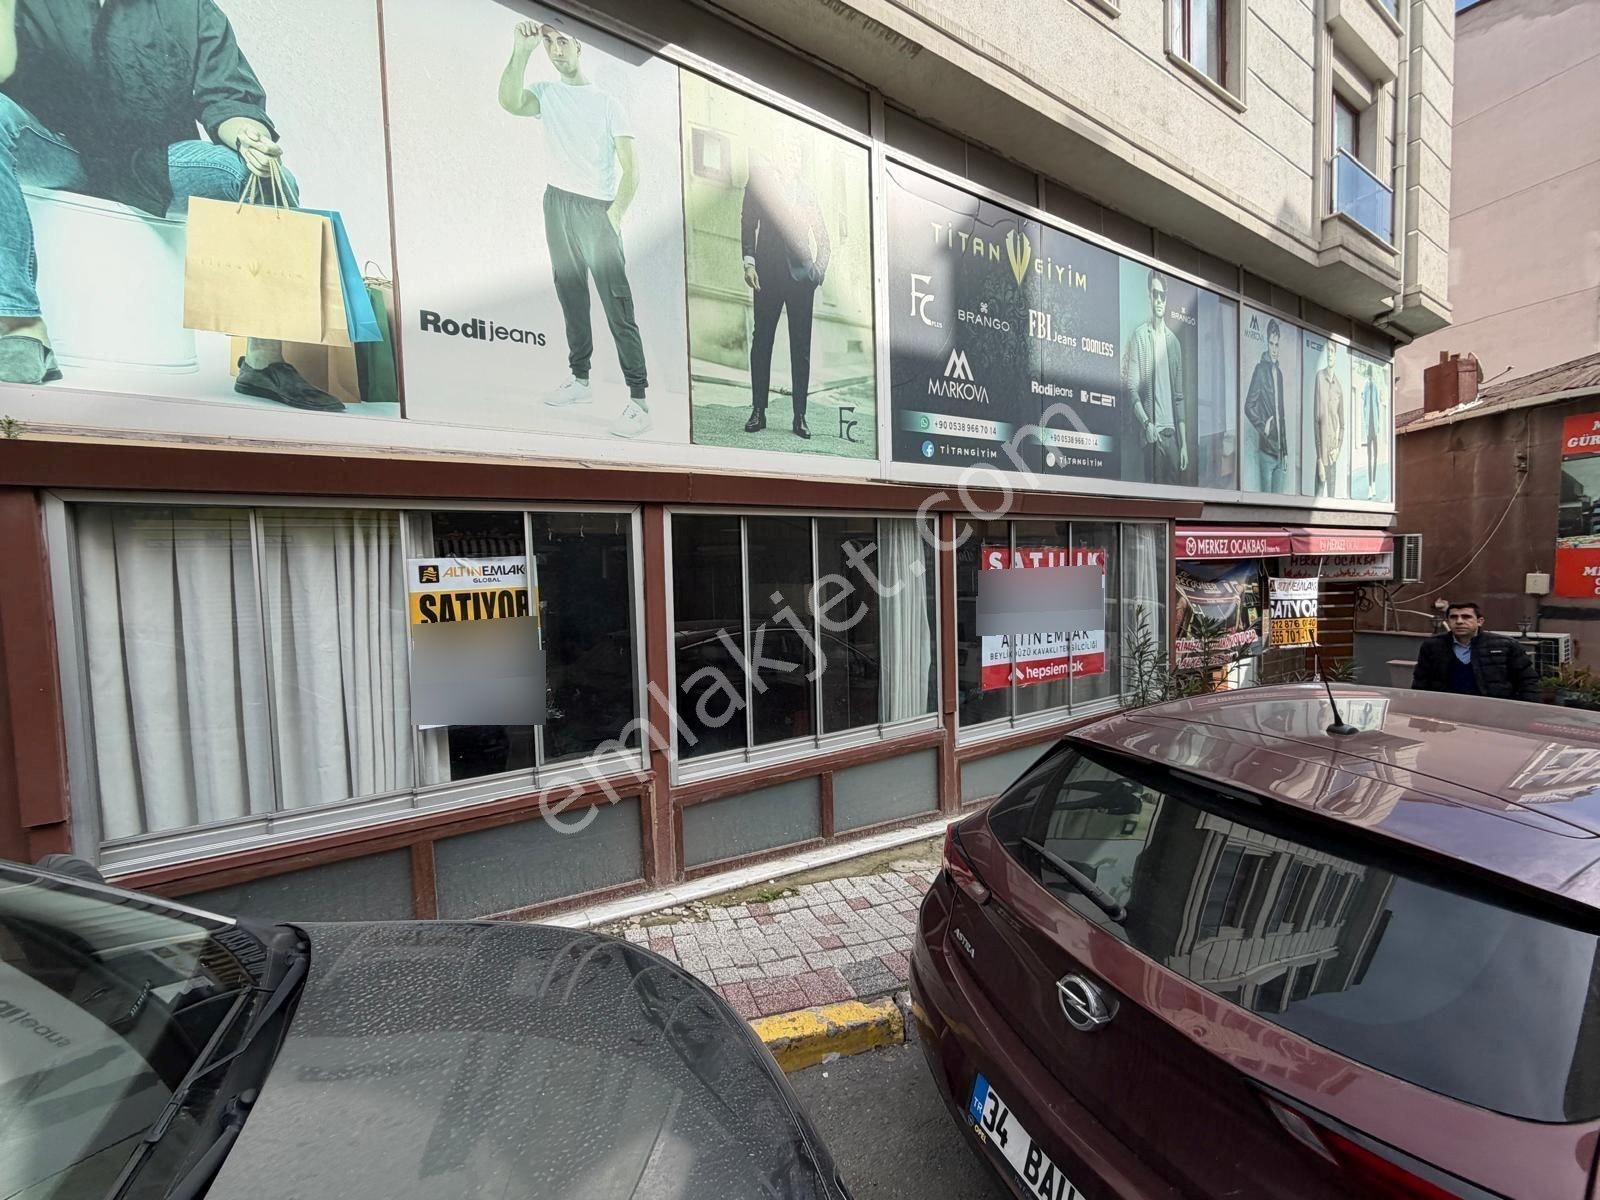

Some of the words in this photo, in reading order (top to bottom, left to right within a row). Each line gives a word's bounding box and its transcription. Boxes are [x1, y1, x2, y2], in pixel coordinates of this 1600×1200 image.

[931, 222, 1000, 262] TİTAN
[1034, 257, 1087, 292] GİYİM
[957, 309, 1010, 332] BRANGO
[1028, 308, 1052, 341] FBI
[928, 377, 990, 405] MARKOVA
[939, 444, 997, 458] TİTANGİYİM
[1198, 539, 1228, 554] MERKEZ
[1230, 539, 1267, 556] OCAKBAŞI
[1026, 660, 1084, 679] hepsiemak
[953, 927, 976, 959] ASTRA
[973, 1096, 983, 1114] TR
[982, 1091, 1009, 1149] 34
[974, 1124, 987, 1145] OPEL
